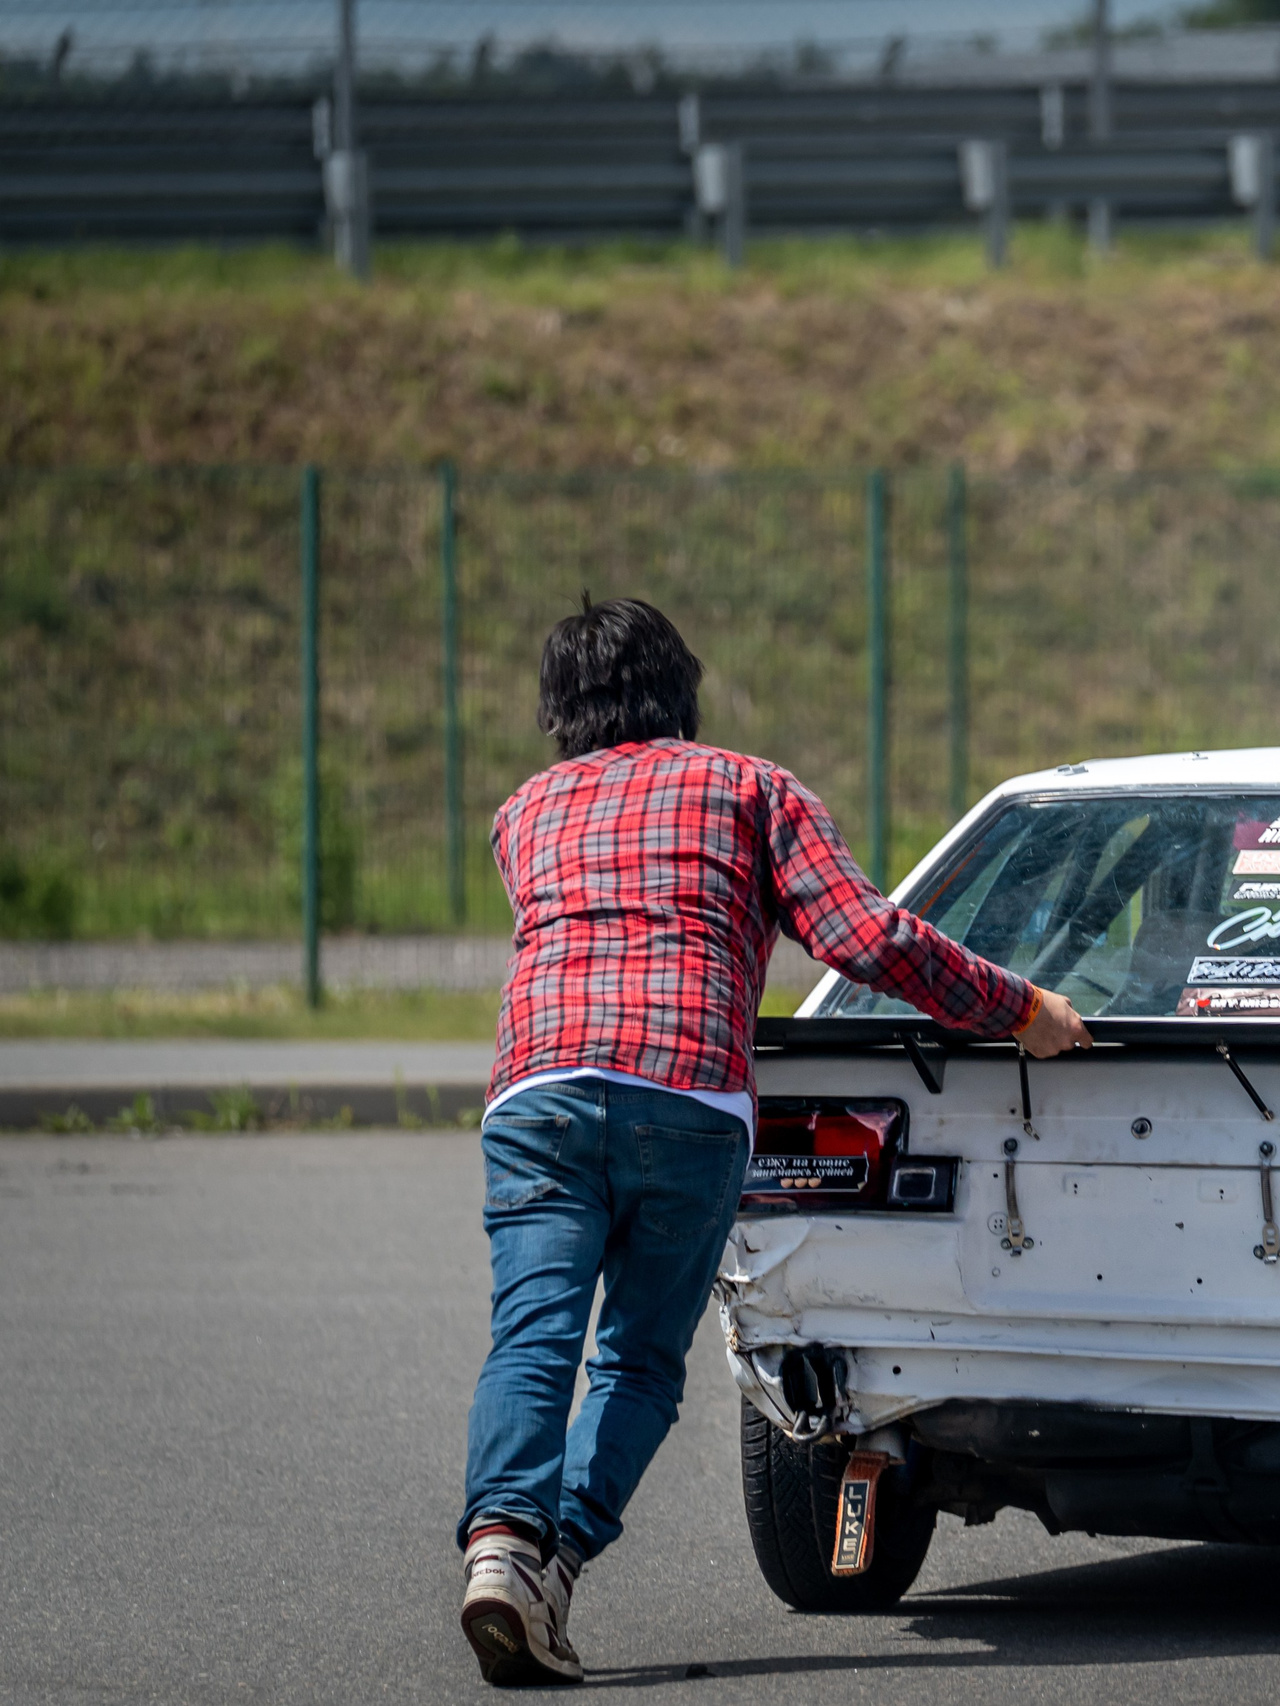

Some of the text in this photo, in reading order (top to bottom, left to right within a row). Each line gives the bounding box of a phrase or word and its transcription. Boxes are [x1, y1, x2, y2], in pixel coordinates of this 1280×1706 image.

[1210, 998, 1238, 1009] MY
[757, 1157, 850, 1170] езжу на говне
[752, 1167, 812, 1178] занимаюсь
[843, 1485, 863, 1554] LUKE
